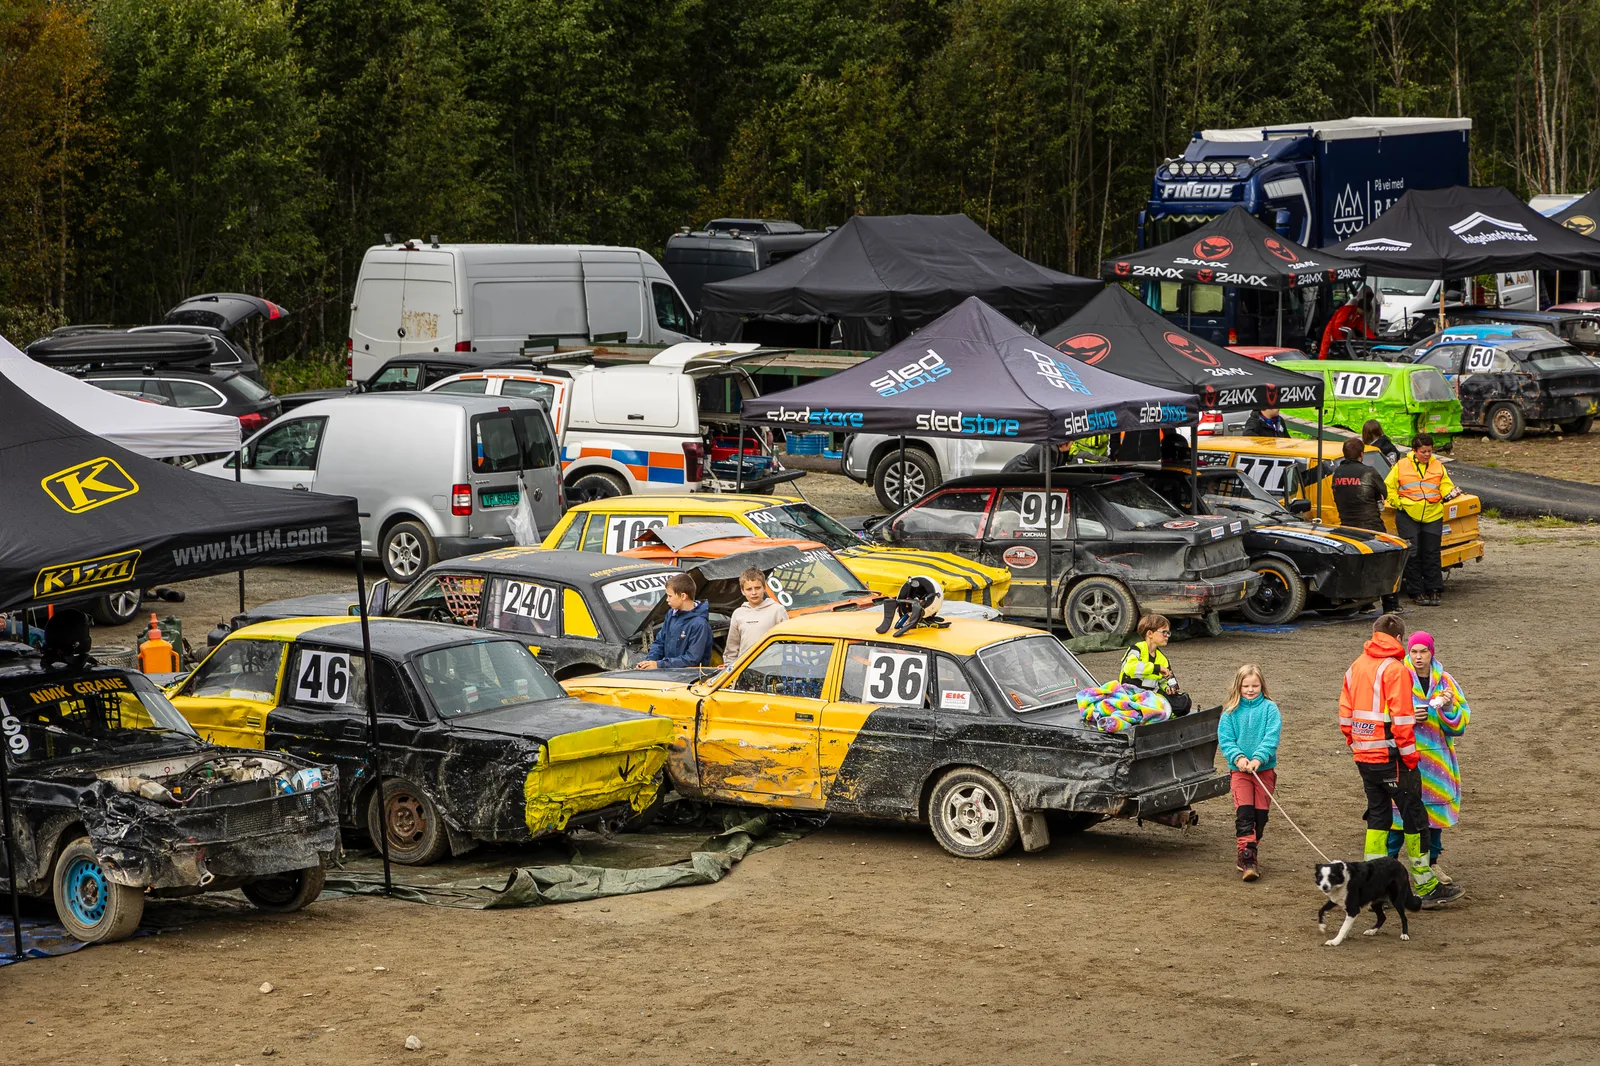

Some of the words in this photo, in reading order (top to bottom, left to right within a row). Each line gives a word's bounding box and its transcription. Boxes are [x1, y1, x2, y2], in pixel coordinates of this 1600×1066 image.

[1374, 179, 1382, 191] På
[1383, 179, 1391, 190] vei
[1391, 177, 1404, 189] med
[1132, 265, 1184, 280] 24MX
[1173, 257, 1229, 269] 24MX
[1337, 268, 1361, 280] 24MX
[1215, 272, 1268, 287] 24MX
[1297, 272, 1323, 284] 24MX
[870, 349, 944, 392] sled
[1023, 348, 1075, 392] sled
[1471, 348, 1493, 367] 50
[879, 363, 952, 398] store
[1341, 374, 1381, 396] 102
[1218, 388, 1258, 405] 24MX
[1280, 386, 1316, 402] 24MX
[766, 406, 864, 428] sledstore
[916, 409, 1020, 436] sledstore
[1064, 409, 1117, 435] sledstore
[1140, 401, 1188, 423] sledstore
[55, 461, 127, 510] K
[1240, 457, 1295, 489] 777
[748, 511, 777, 524] 100
[1022, 494, 1063, 526] 99
[173, 525, 328, 566] www.KLIM.com
[613, 519, 664, 553] 10
[41, 560, 131, 594] Klim
[504, 582, 552, 619] 240
[29, 685, 72, 704] NMK
[73, 677, 127, 694] GRANE
[299, 654, 347, 701] 46
[870, 656, 923, 700] 36
[945, 692, 966, 700] EIK
